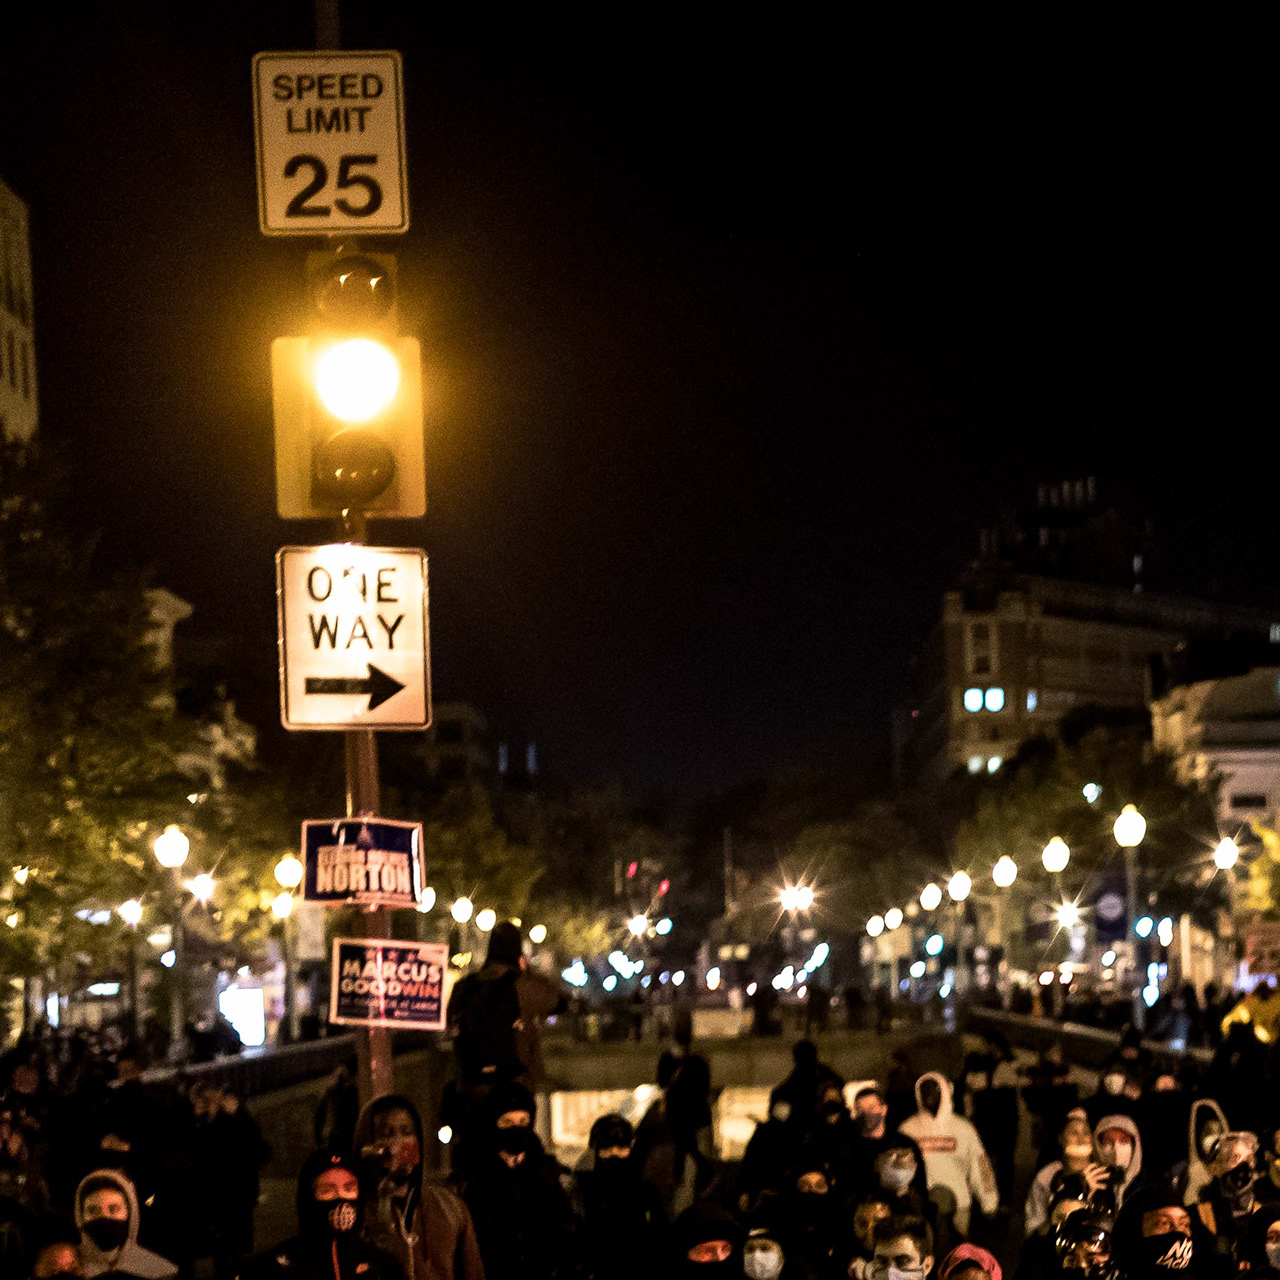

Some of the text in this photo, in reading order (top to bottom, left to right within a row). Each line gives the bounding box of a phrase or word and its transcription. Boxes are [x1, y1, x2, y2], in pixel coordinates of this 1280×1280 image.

[273, 73, 383, 101] SPEED
[287, 107, 372, 133] LIMIT
[284, 153, 383, 218] 25
[308, 613, 406, 650] WAY
[316, 864, 411, 893] NORTON
[343, 959, 441, 982] MARCUS
[341, 978, 440, 998] GOODWIN
